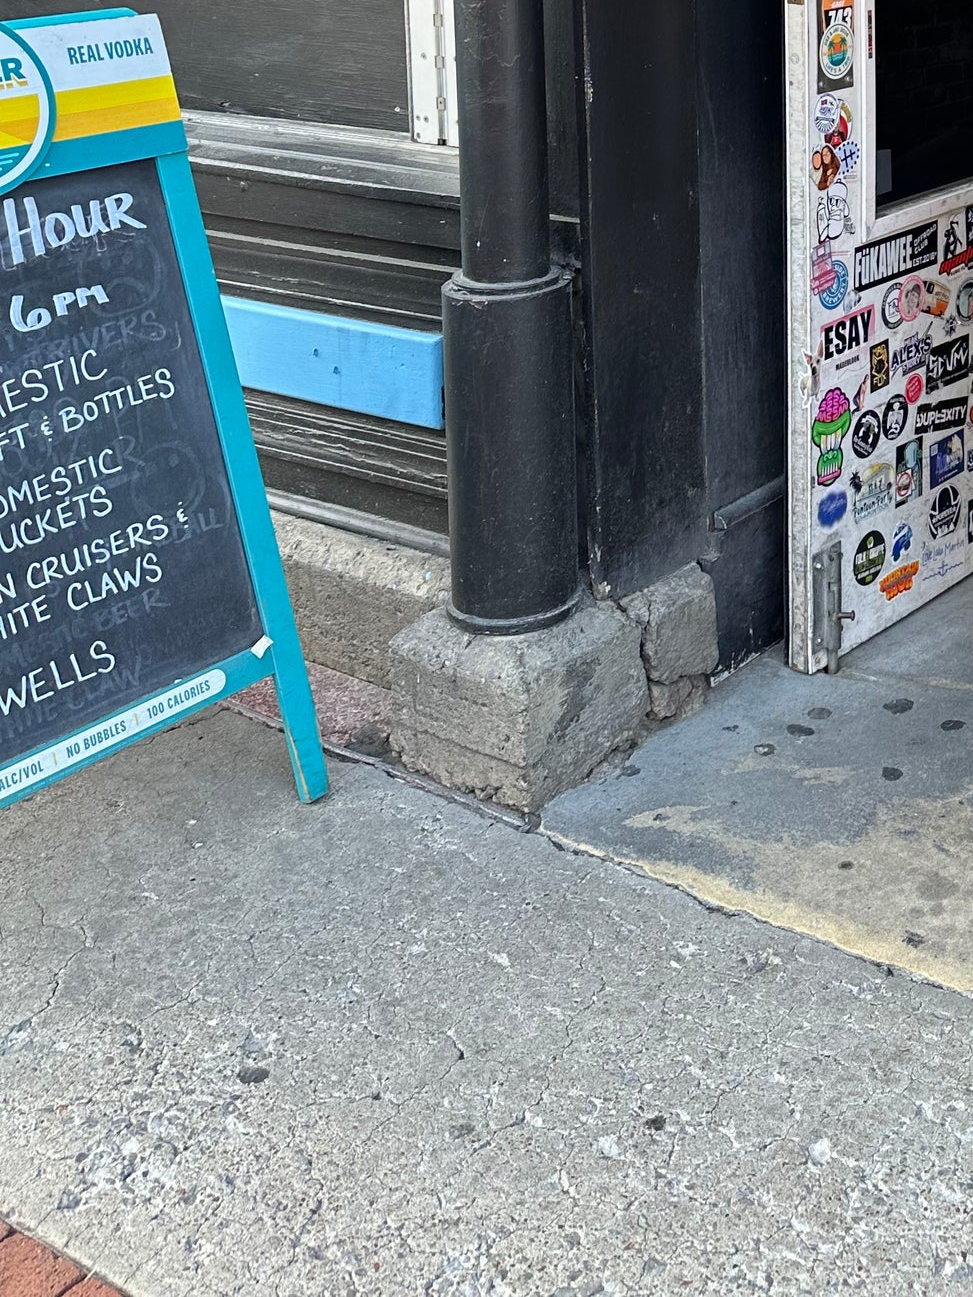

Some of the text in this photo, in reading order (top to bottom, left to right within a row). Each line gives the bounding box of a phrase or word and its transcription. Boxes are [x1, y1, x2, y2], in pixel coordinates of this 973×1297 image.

[0, 57, 28, 88] R
[67, 37, 154, 65] REAL VODKA
[3, 192, 148, 265] HOUR
[914, 238, 929, 254] CLUB
[823, 309, 872, 361] ESAY
[58, 368, 176, 433] BOTTLES
[26, 514, 169, 590] CRUISERS
[66, 552, 163, 611] CLAWS
[0, 640, 116, 716] WELLS
[65, 744, 81, 759] NO
[83, 720, 127, 751] BUBBLES
[147, 704, 165, 720] 100
[167, 679, 211, 710] CALORIES
